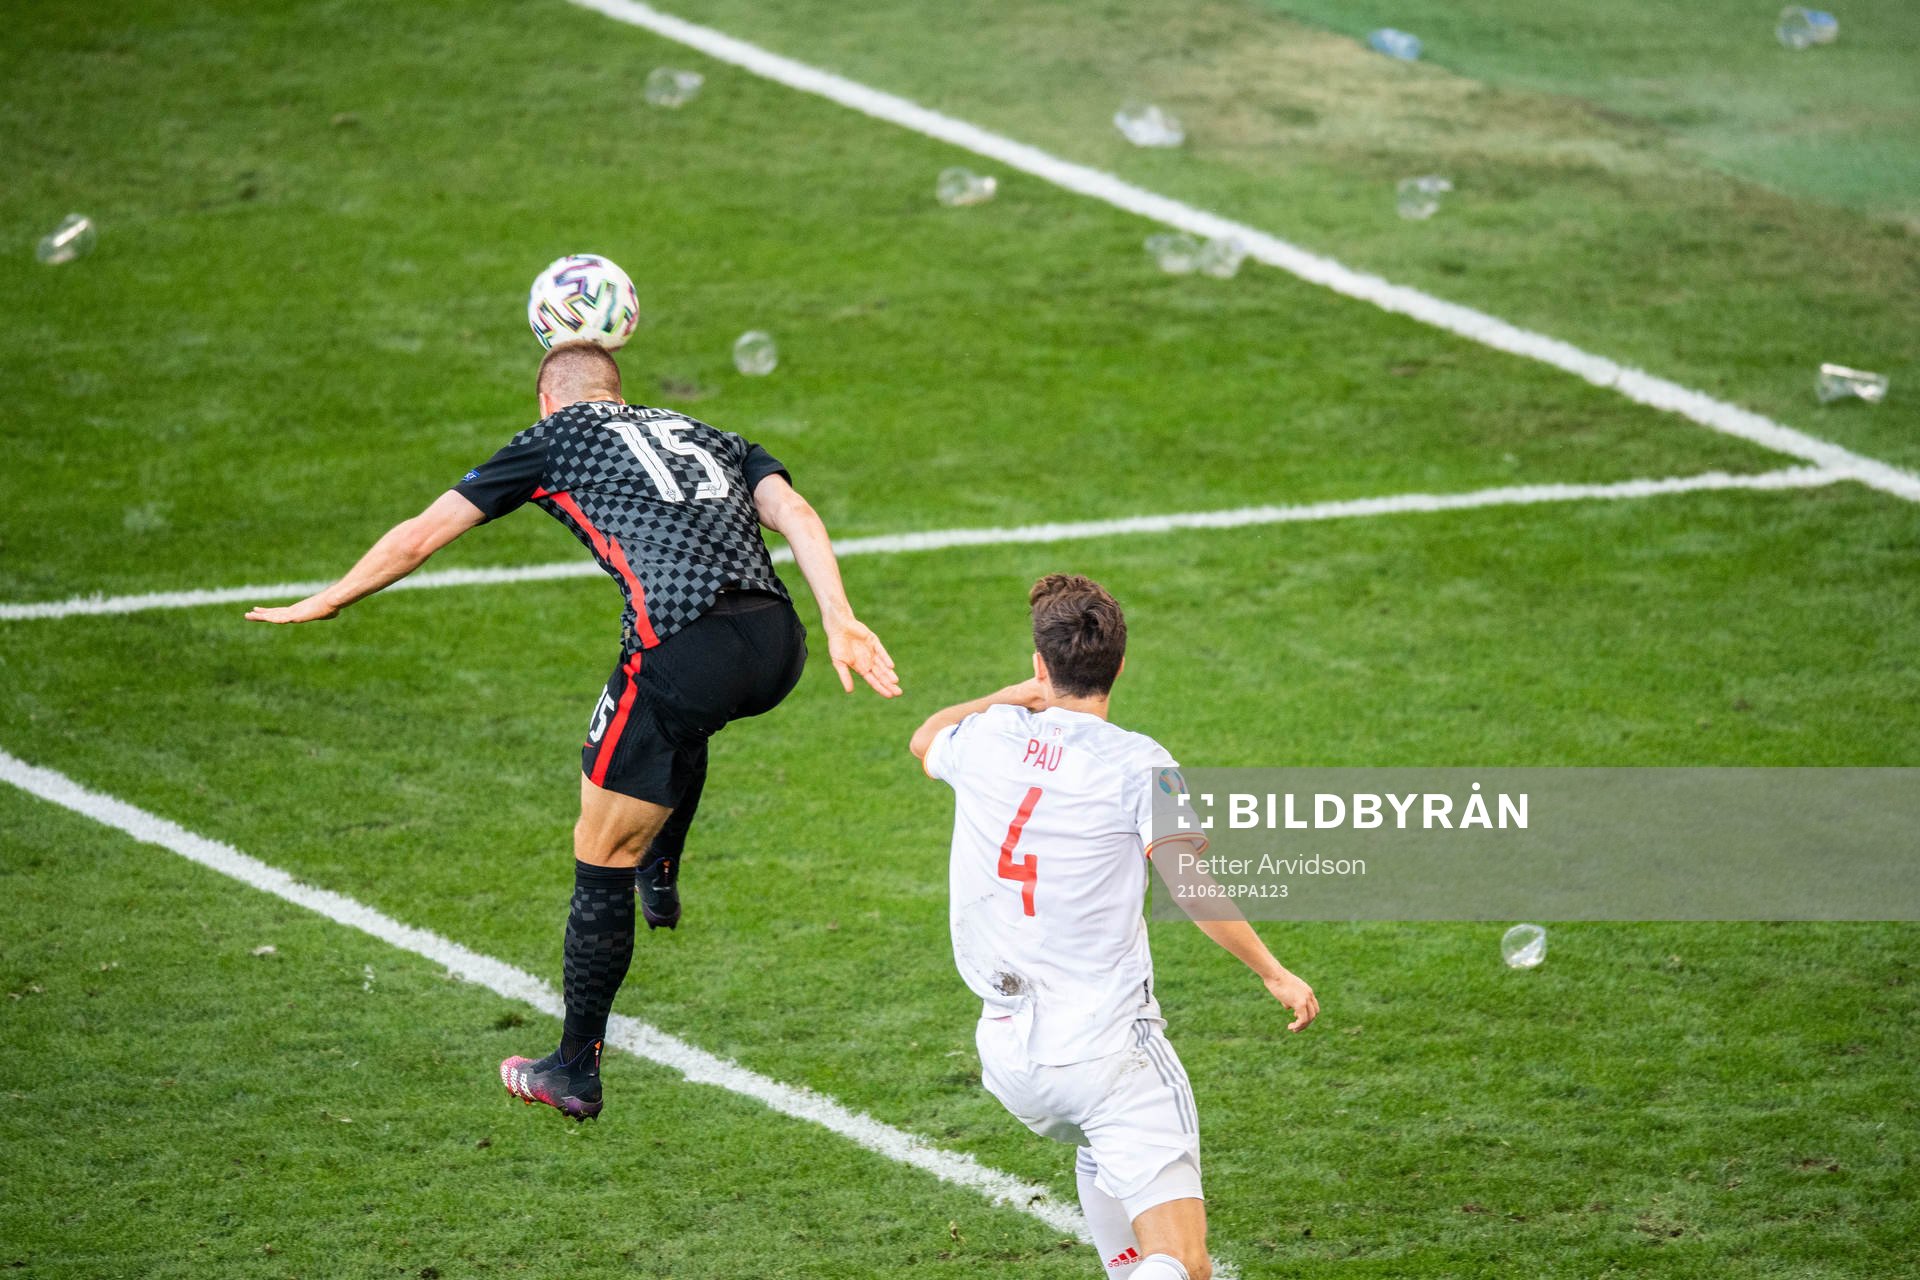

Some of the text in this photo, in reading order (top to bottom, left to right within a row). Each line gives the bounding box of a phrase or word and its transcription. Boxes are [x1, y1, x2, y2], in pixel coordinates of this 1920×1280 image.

[601, 420, 729, 502] 15
[1023, 738, 1063, 772] PAU
[998, 786, 1043, 917] 4
